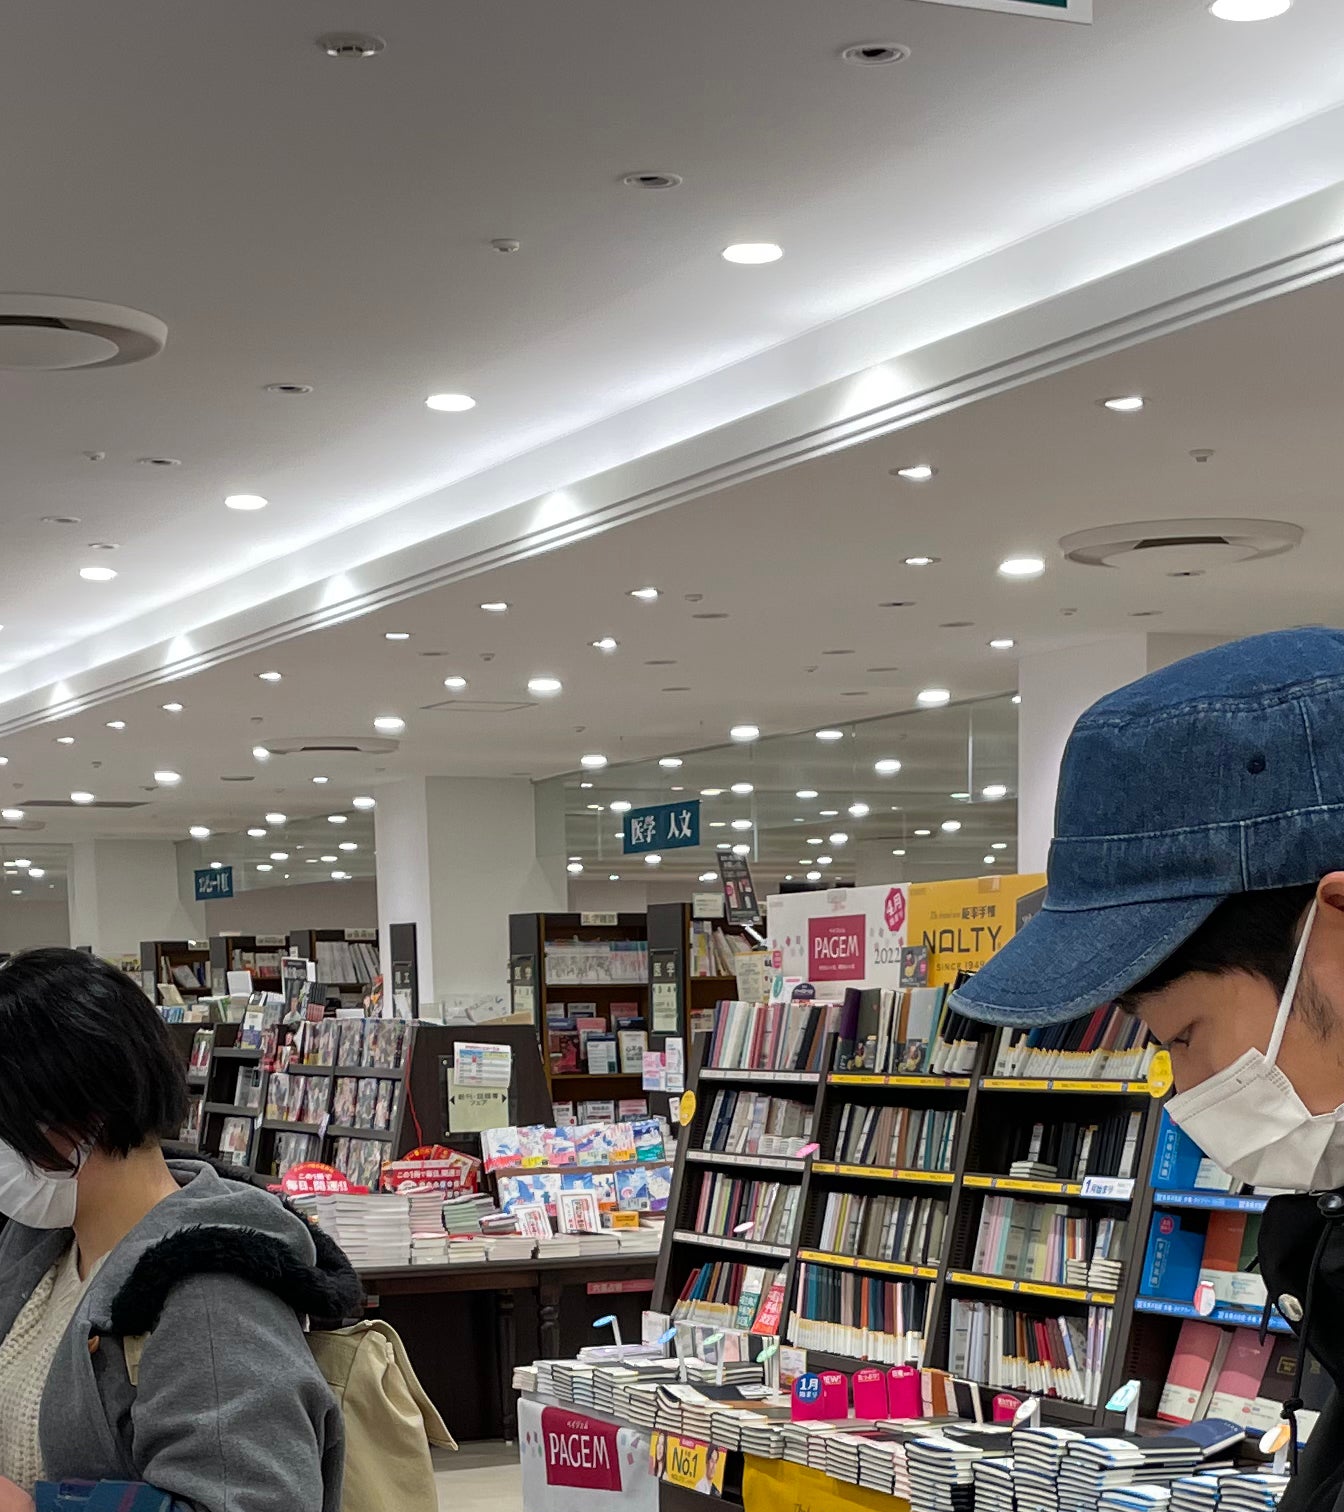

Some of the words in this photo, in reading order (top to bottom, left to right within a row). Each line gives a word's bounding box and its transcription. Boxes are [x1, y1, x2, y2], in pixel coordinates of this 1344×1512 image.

[631, 816, 655, 845] 医学
[667, 810, 692, 839] 人文
[887, 893, 902, 916] 4月
[815, 935, 859, 959] PAGEM
[923, 925, 1002, 954] NOLTY
[874, 949, 901, 964] 2022
[800, 1378, 818, 1391] 1月
[549, 1433, 610, 1469] PAGEM
[672, 1447, 698, 1478] No.1
